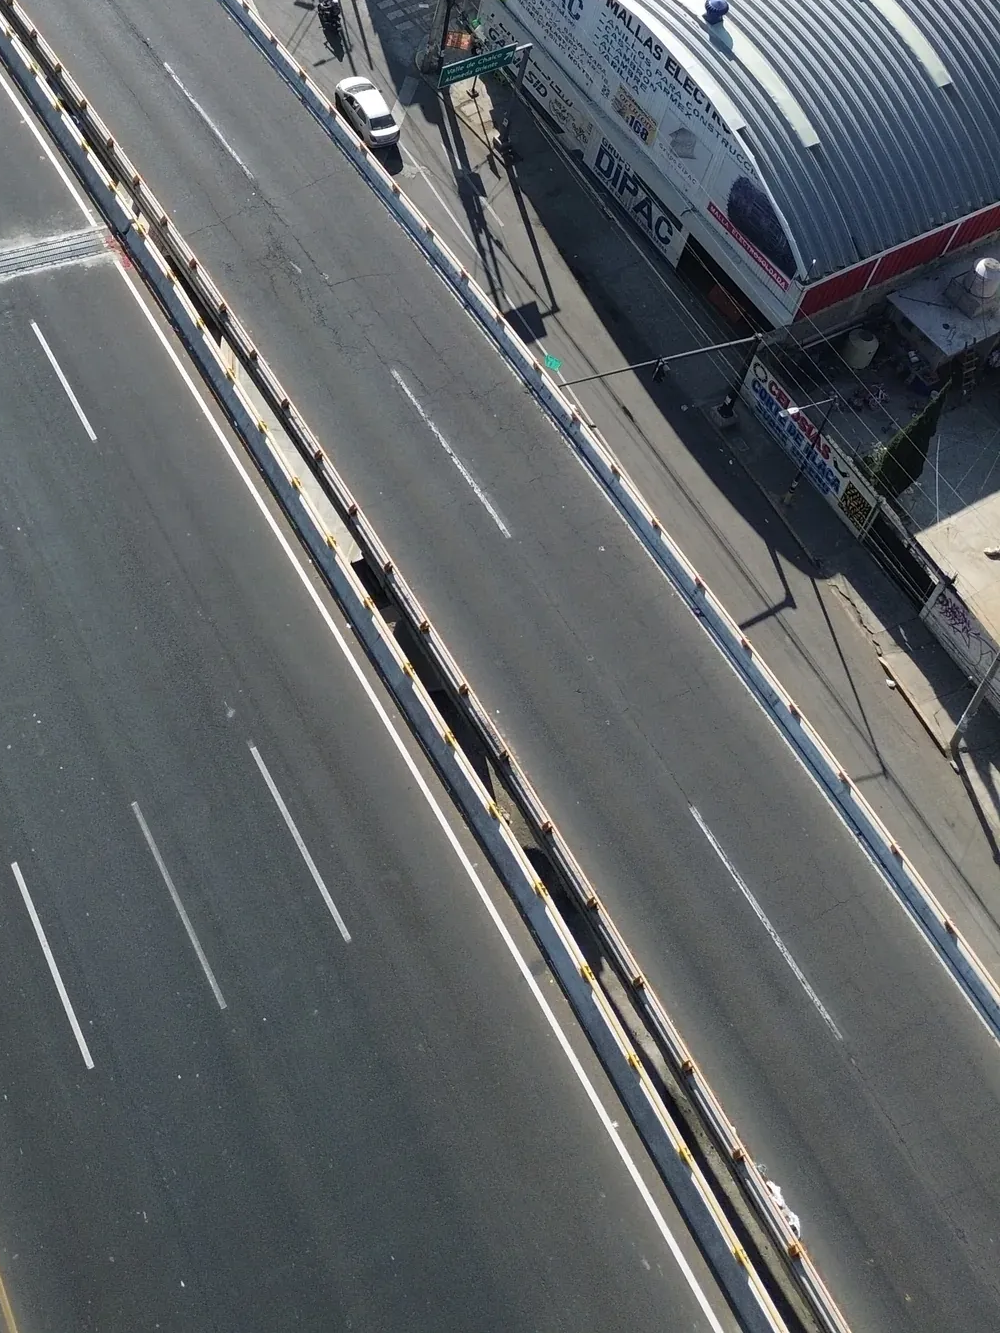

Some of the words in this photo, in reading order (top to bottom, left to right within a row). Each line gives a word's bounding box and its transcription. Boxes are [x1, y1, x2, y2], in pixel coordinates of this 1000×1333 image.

[444, 70, 473, 83] Alameda
[475, 62, 498, 73] Oriente
[446, 66, 464, 75] Valle
[477, 52, 502, 65] Chalco
[597, 46, 640, 95] VARILLA
[599, 39, 648, 93] ALAMBRE
[601, 31, 657, 93] ALAMBRON
[603, 23, 653, 78] CASTILLO
[606, 17, 652, 68] ANILLOS
[654, 67, 683, 100] PARA
[601, 137, 631, 172] GRUPO
[710, 205, 729, 230] MALLA
